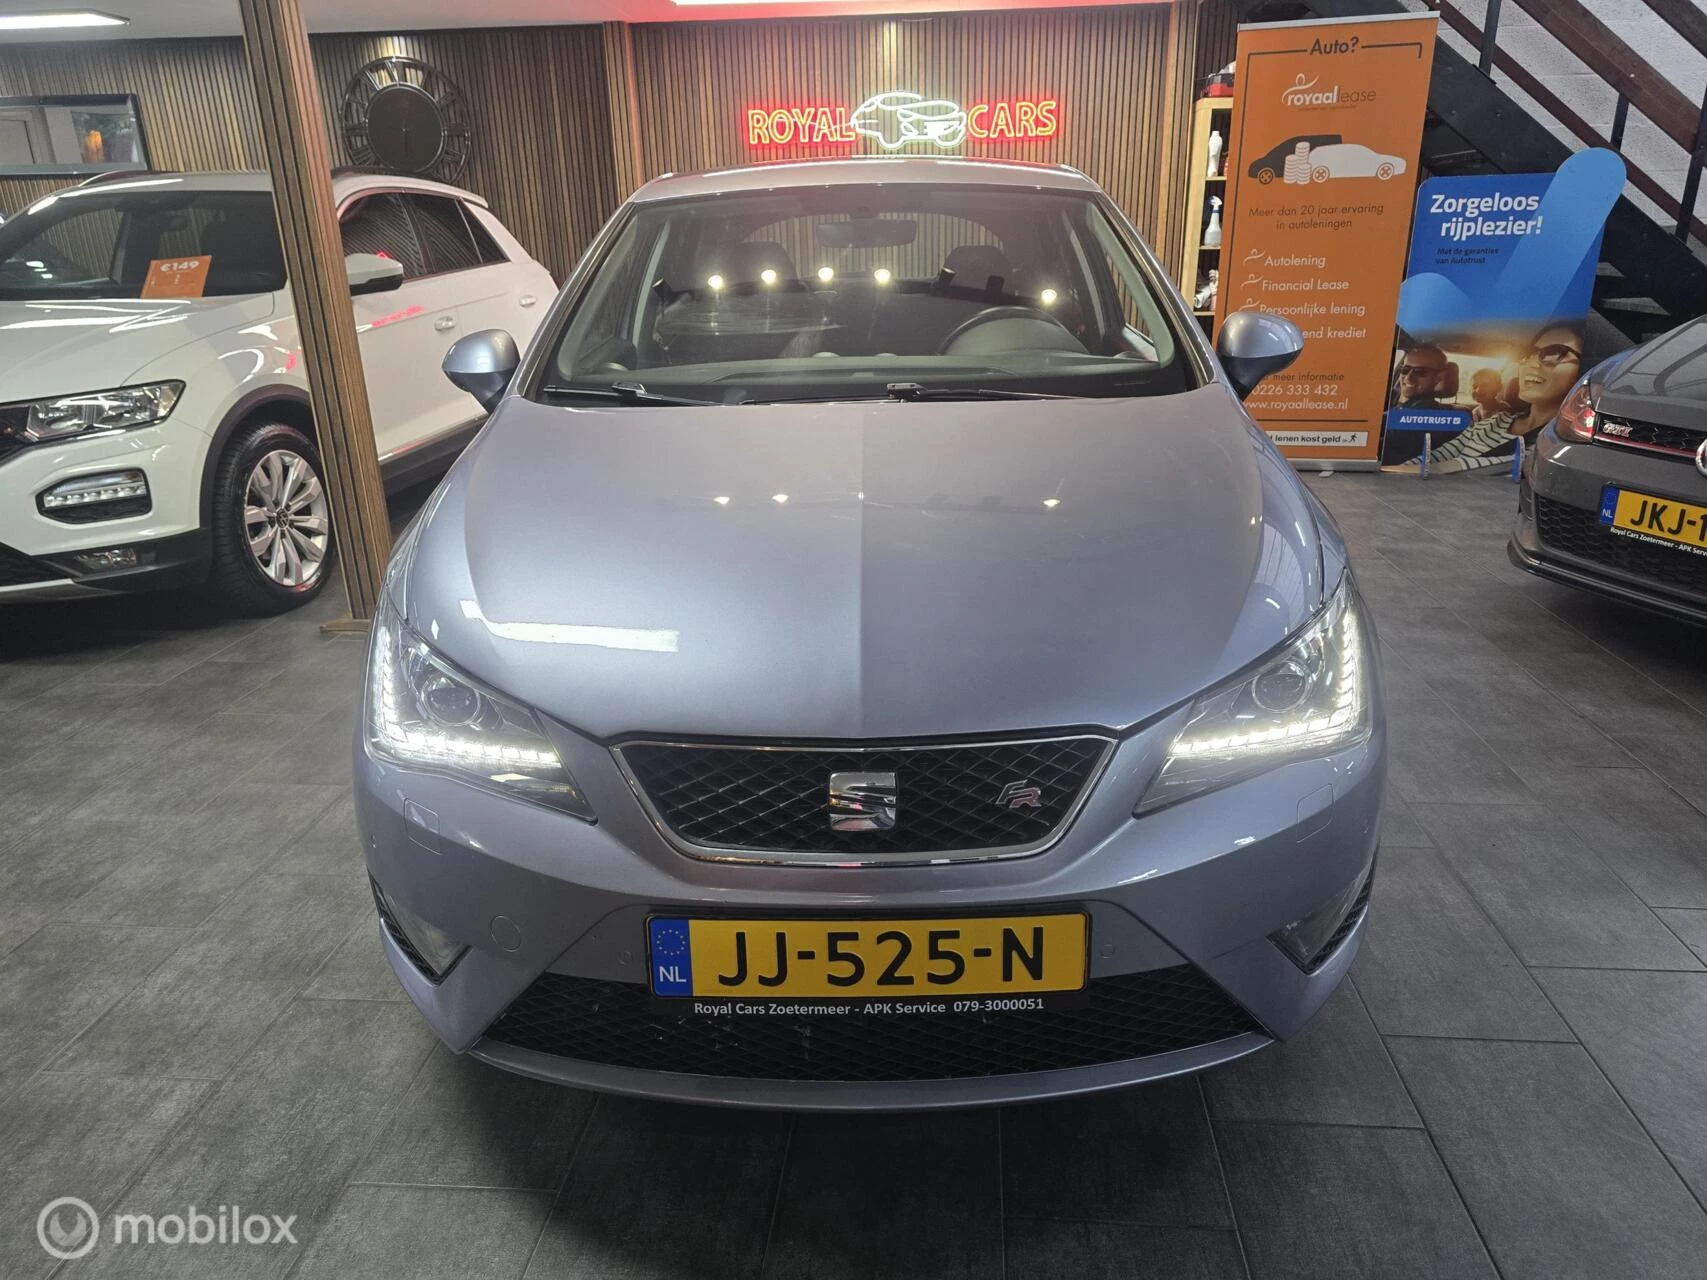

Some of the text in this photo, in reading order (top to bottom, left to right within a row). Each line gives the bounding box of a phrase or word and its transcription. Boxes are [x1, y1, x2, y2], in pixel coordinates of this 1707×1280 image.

[1309, 36, 1360, 56] Auto?
[748, 101, 1057, 145] ROYAL CARS
[1248, 203, 1384, 217] Meer dan 20 jaar ervaring
[1430, 192, 1540, 218] Zorgeloos
[1276, 218, 1353, 231] in autoleningen
[1440, 215, 1544, 241] rijplezier!
[1436, 247, 1452, 255] Met
[1464, 247, 1500, 256] garanties
[1264, 254, 1326, 268] Autolening
[1262, 278, 1350, 291] Financial Lease
[1259, 302, 1366, 317] Persoonlijke lening
[1327, 326, 1367, 338] krediet
[1298, 371, 1345, 381] informatie
[1287, 384, 1310, 395] 333
[1314, 384, 1338, 395] 432
[1400, 415, 1452, 425] AUTOTRUST
[1321, 435, 1341, 444] geld
[1602, 508, 1614, 518] NL
[1610, 527, 1626, 536] Royal
[1626, 531, 1639, 539] Cars
[1639, 534, 1674, 548] Zoetermeer
[1679, 544, 1692, 552] APK
[718, 926, 1044, 987] JJ-525-N
[658, 966, 687, 983] NL
[694, 1003, 732, 1016] Royal
[735, 1003, 765, 1014] Cars
[769, 1003, 850, 1015] Zoetermeer
[863, 1003, 892, 1014] APK
[895, 1001, 946, 1014] Service
[953, 998, 1044, 1012] 079-3000051
